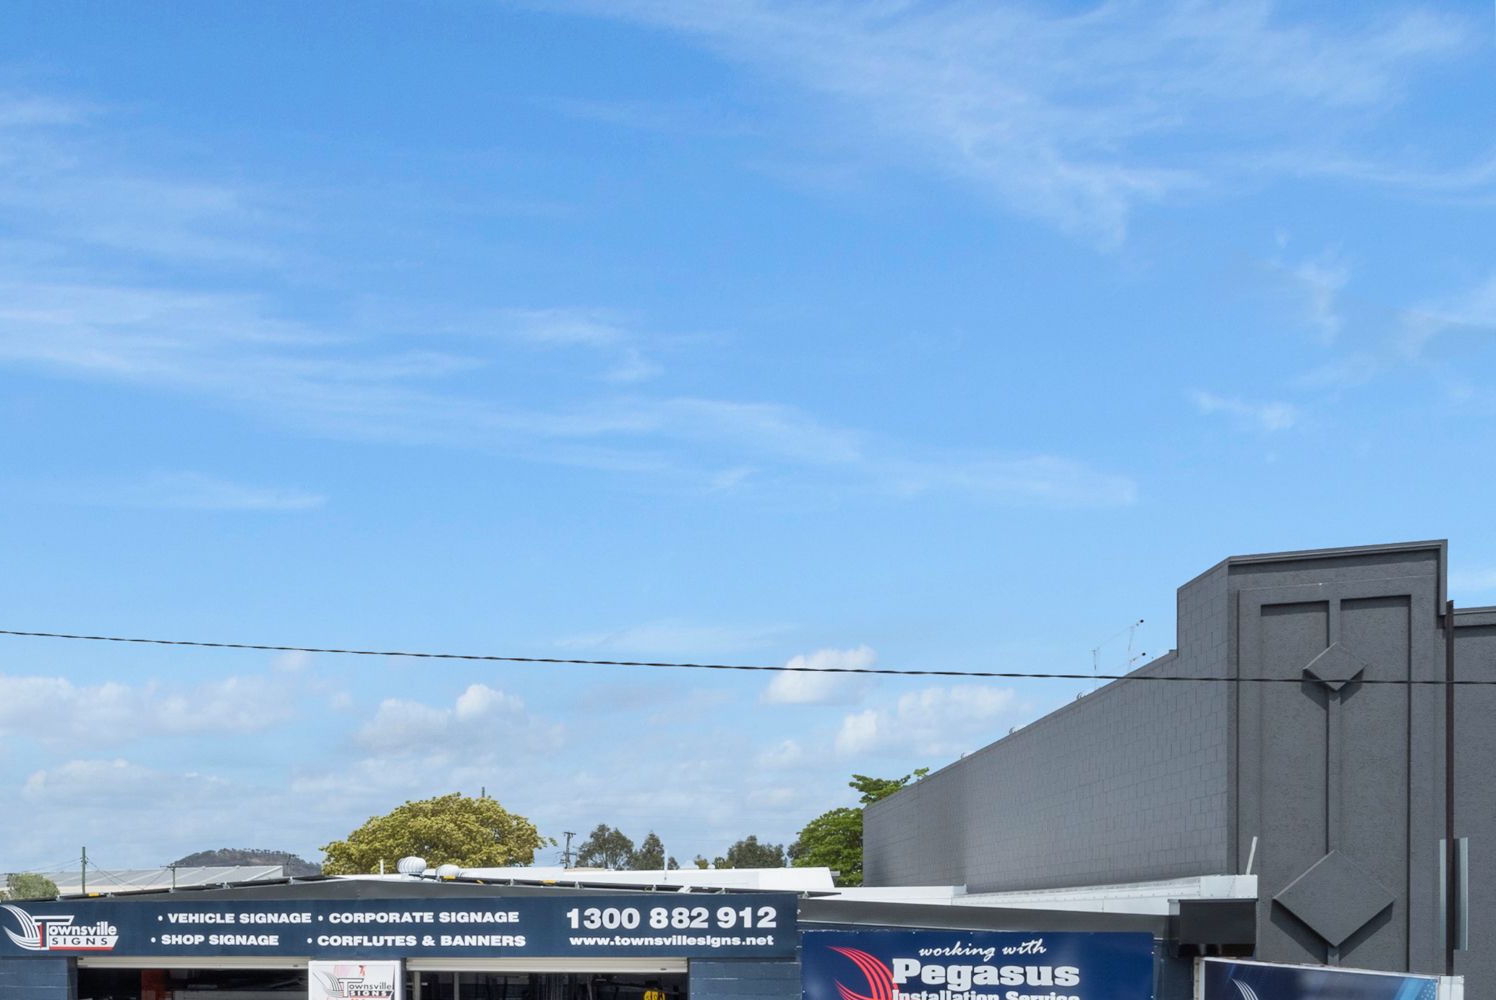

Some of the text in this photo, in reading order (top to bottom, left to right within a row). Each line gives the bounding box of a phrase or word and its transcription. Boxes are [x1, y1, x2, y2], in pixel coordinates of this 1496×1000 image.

[167, 913, 312, 924] VEHICLE SIGNAGE
[328, 911, 519, 924] CORPORATE SIGNAGE
[566, 906, 777, 929] 1300 882 912
[31, 915, 118, 950] Townsville
[51, 937, 108, 945] SIGNS
[161, 934, 279, 946] SHOP SIGNAGE
[317, 935, 527, 947] CORFLUTES & BANNERS
[569, 935, 774, 947] www.townsvillesigns.net
[919, 938, 1047, 961] working with
[892, 958, 1080, 991] Pegasus
[338, 978, 392, 998] Townsville
